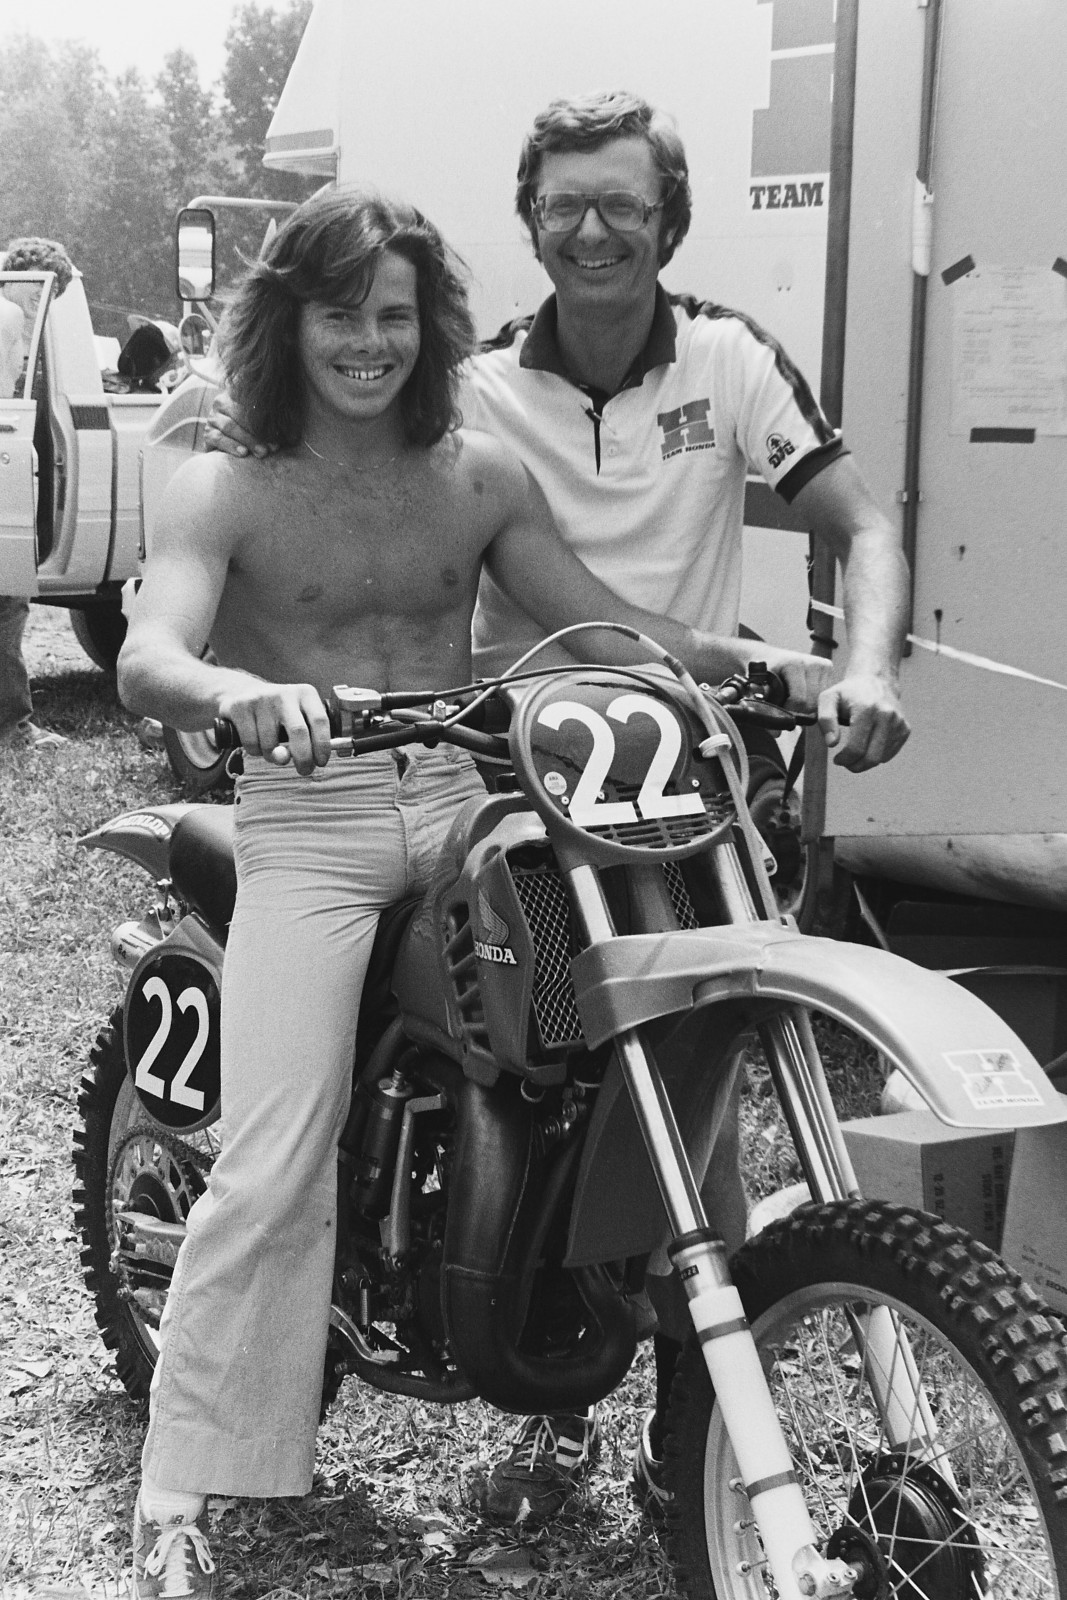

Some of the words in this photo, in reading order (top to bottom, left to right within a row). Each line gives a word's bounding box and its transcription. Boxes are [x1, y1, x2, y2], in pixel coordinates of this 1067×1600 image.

[750, 182, 824, 210] TEAM
[662, 448, 682, 460] TEAM
[685, 442, 715, 452] HONDA
[537, 694, 707, 827] 22
[134, 976, 210, 1112] 22
